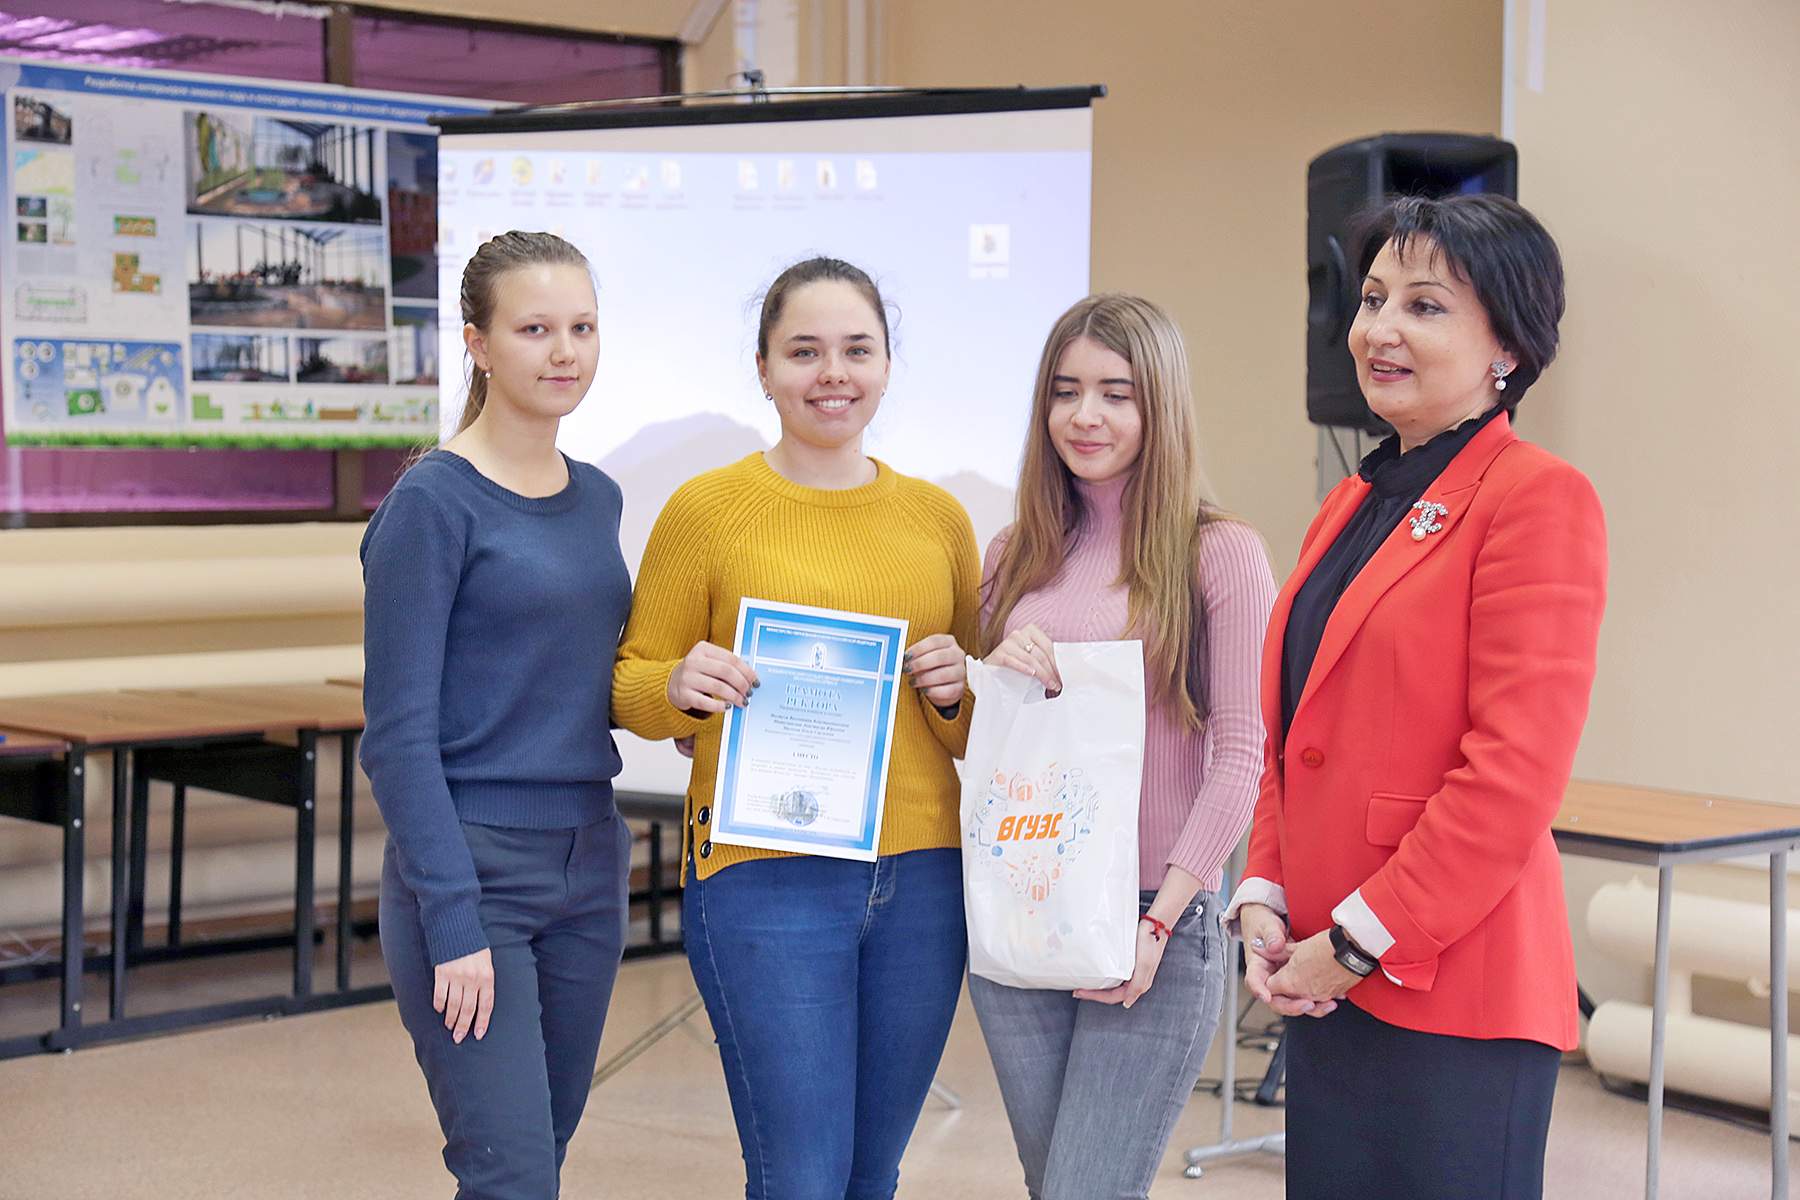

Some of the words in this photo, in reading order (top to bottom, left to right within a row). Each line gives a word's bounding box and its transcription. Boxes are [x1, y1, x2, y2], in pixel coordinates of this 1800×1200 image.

[786, 684, 841, 700] ГРАМОТА
[786, 697, 839, 712] РЕКТОРА
[997, 812, 1064, 841] ВГУЭС
